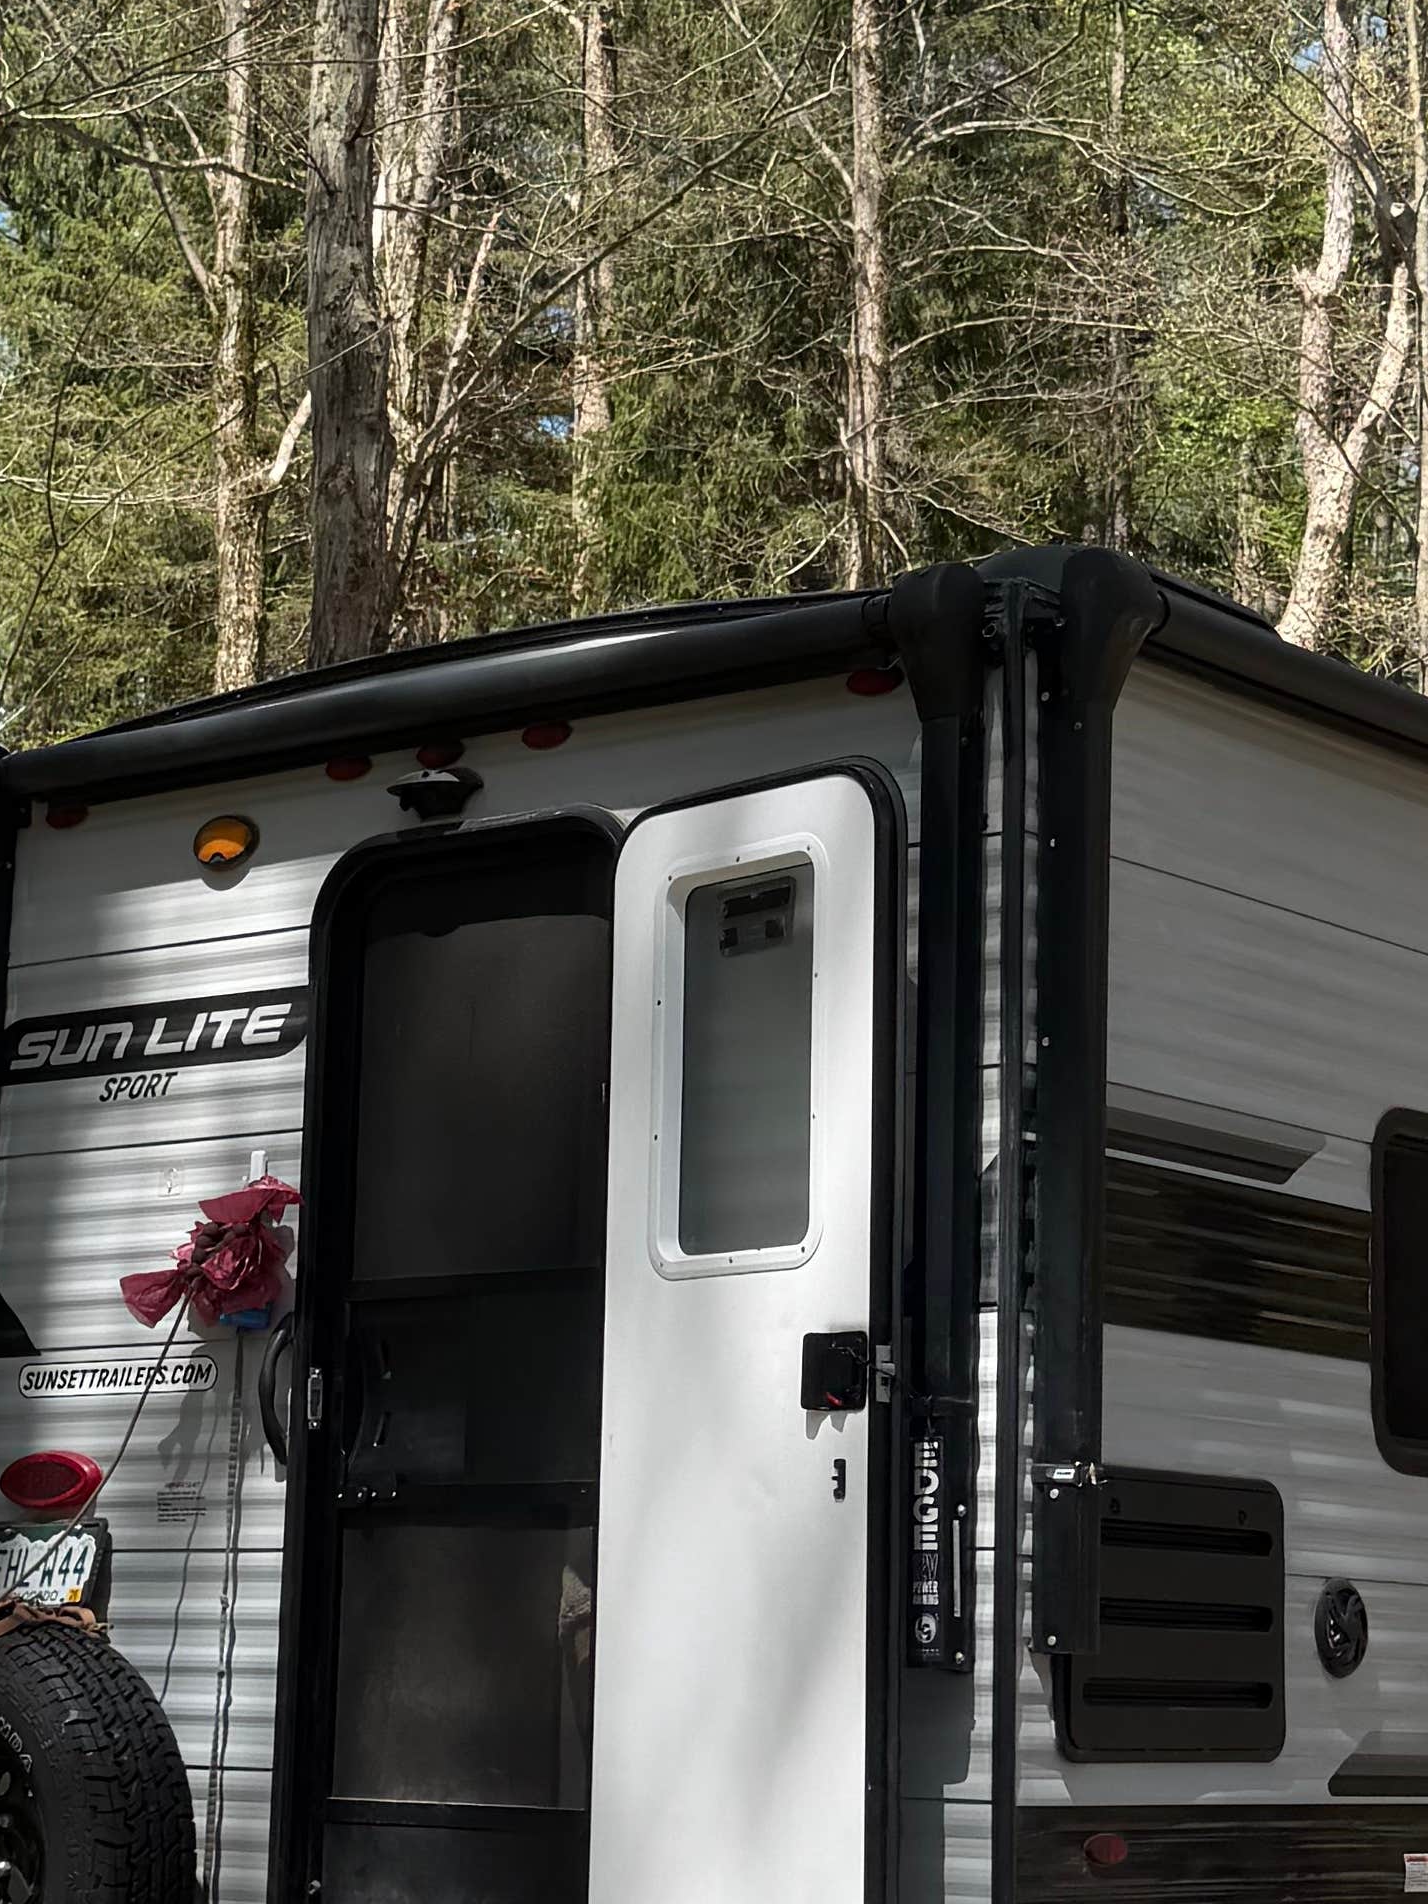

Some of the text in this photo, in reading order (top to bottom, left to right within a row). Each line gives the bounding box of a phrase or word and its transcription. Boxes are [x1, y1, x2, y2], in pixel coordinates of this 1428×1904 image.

[10, 1003, 292, 1071] SUN LITE
[99, 1071, 178, 1102] SPORT
[23, 1363, 213, 1391] SUNSETTRAILERS.COM
[913, 1441, 939, 1550] EDGE
